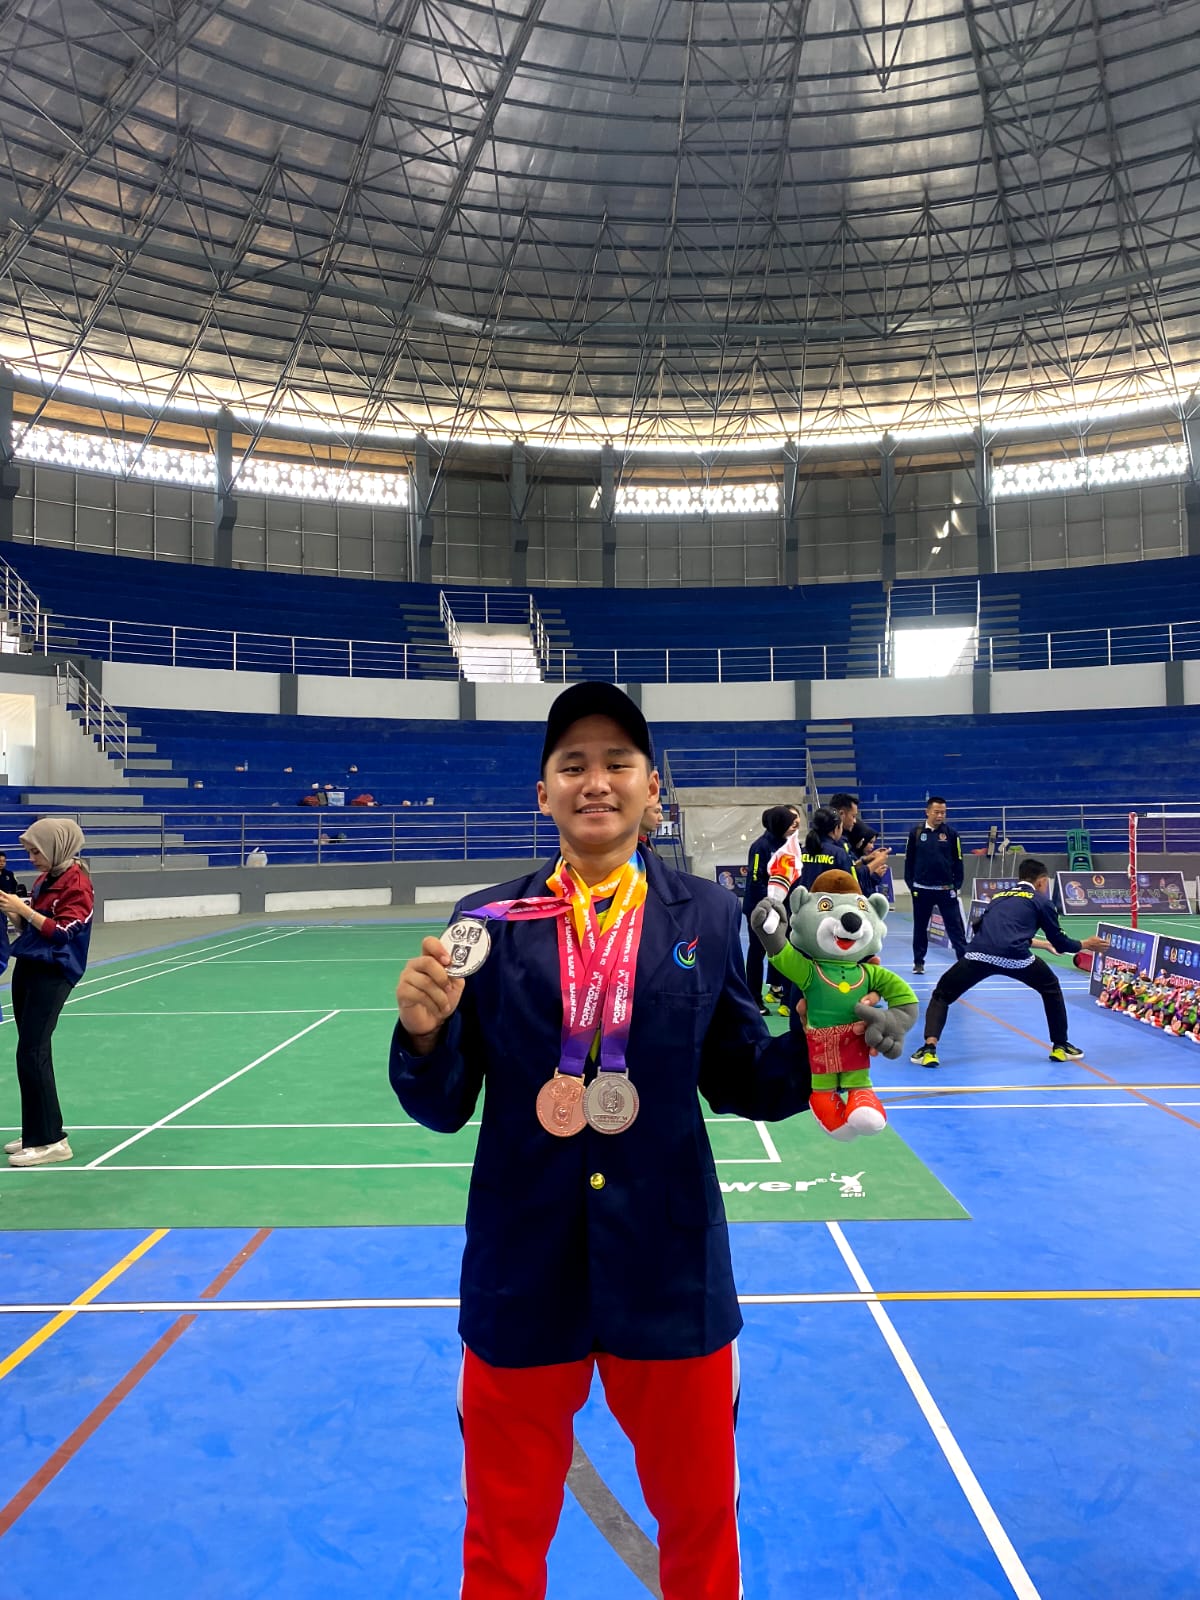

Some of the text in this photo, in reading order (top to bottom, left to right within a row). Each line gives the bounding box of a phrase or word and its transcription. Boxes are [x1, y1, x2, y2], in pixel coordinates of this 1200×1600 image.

[579, 971, 600, 1028] PORPROV VI
[612, 969, 626, 1024] PORPROV VI
